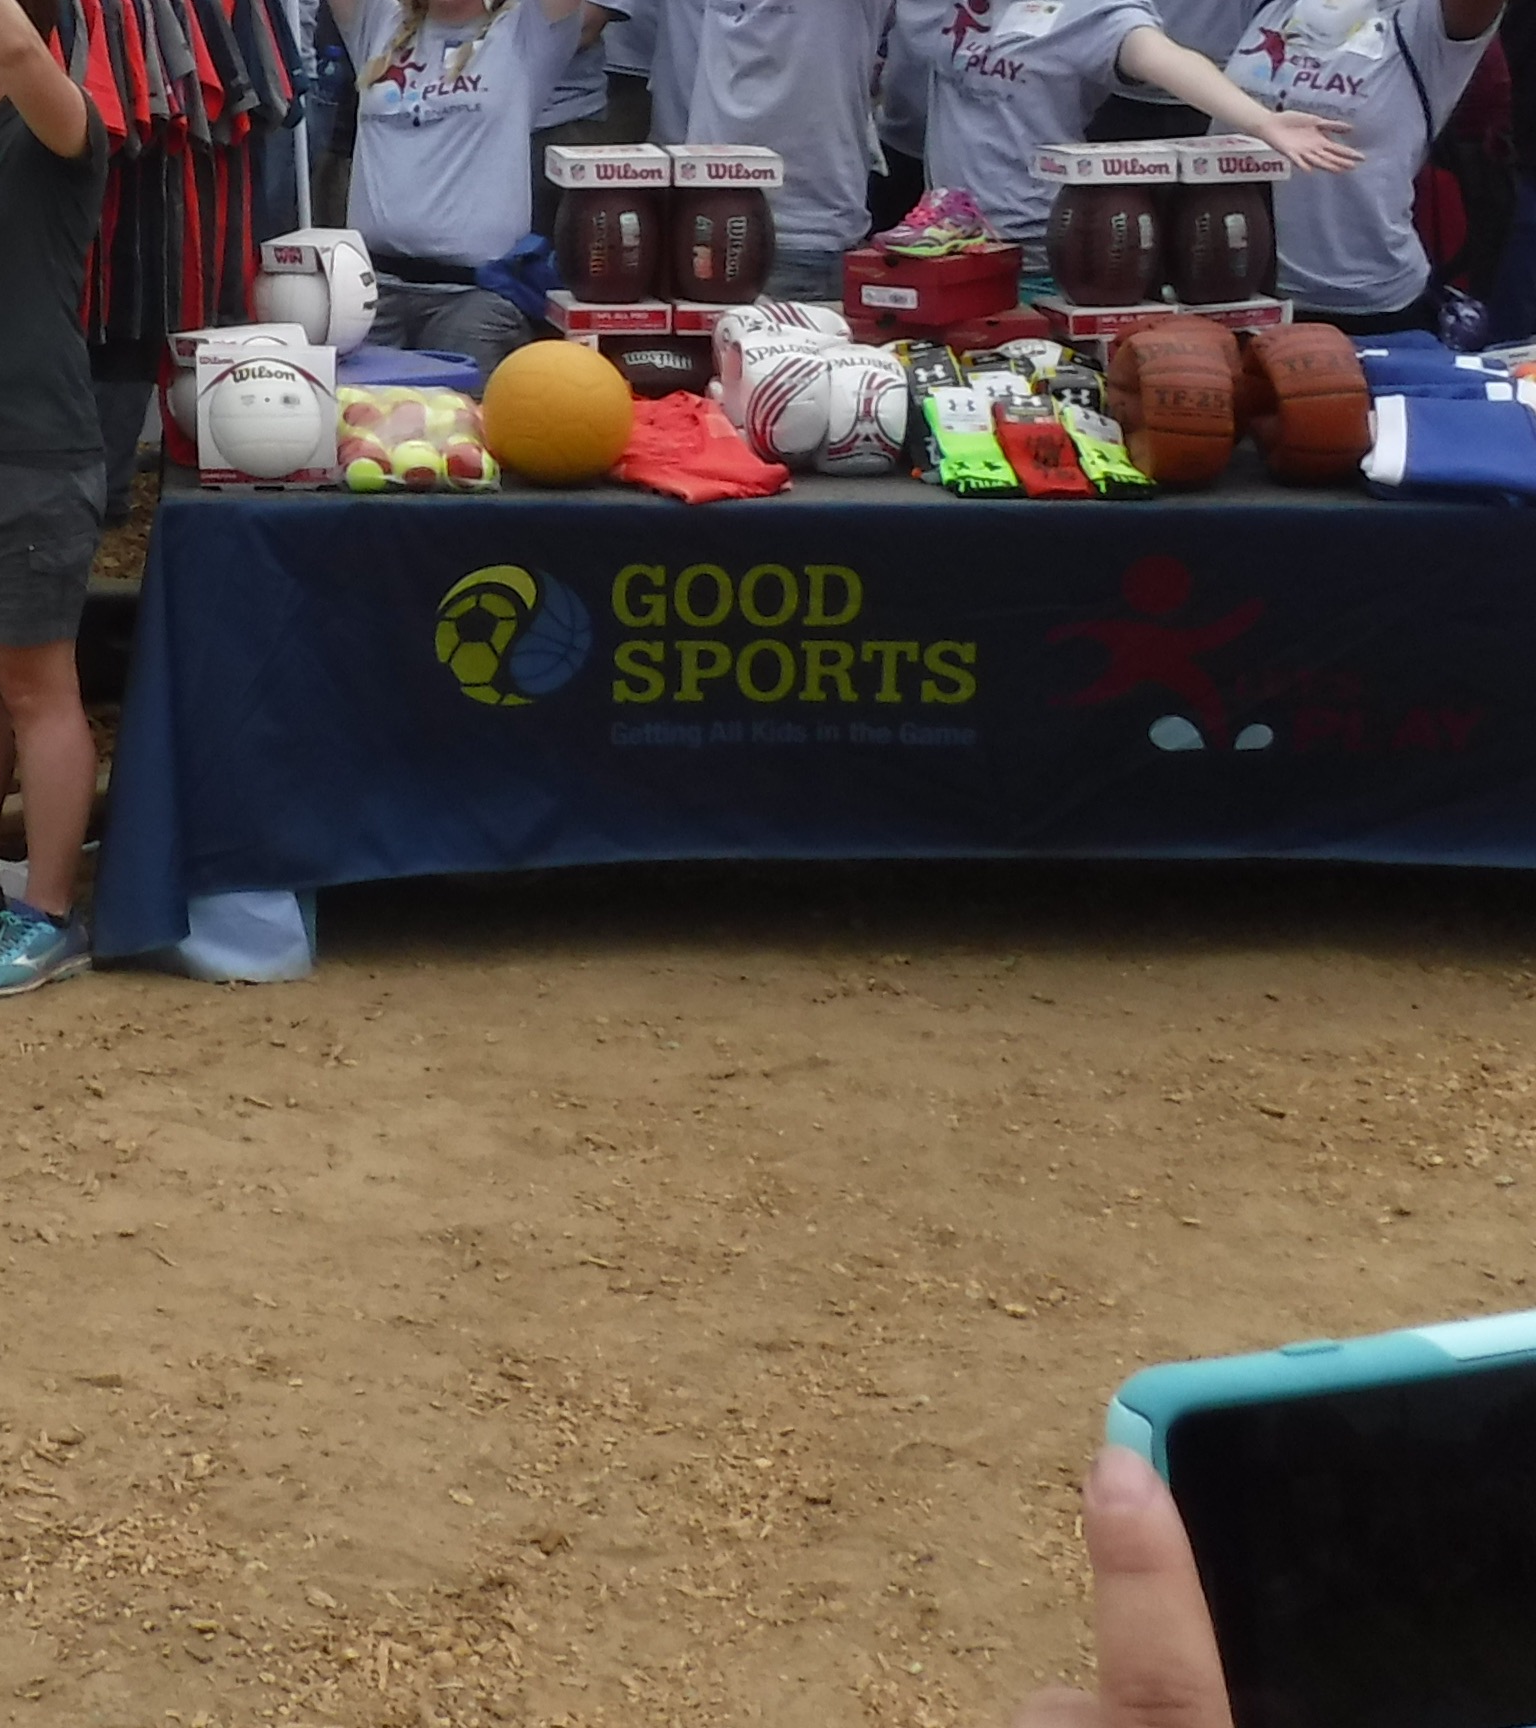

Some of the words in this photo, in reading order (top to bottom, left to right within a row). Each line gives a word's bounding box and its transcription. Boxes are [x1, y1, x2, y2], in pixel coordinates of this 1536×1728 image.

[965, 55, 1025, 82] PLAY
[422, 75, 482, 101] PLAY
[1292, 71, 1364, 96] PLAY
[595, 162, 663, 181] Wilson
[706, 162, 777, 181] Wilson
[1102, 158, 1171, 176] Wilson
[1217, 156, 1285, 173] Wilson
[230, 365, 297, 383] Wilson
[611, 563, 864, 627] GOOD
[612, 639, 977, 704] SPORTS
[610, 721, 703, 748] Getting
[710, 720, 743, 742] All
[751, 721, 807, 742] Kids
[817, 722, 840, 742] in
[849, 722, 892, 743] the
[899, 722, 977, 744] Game
[1291, 706, 1486, 753] PLAY
